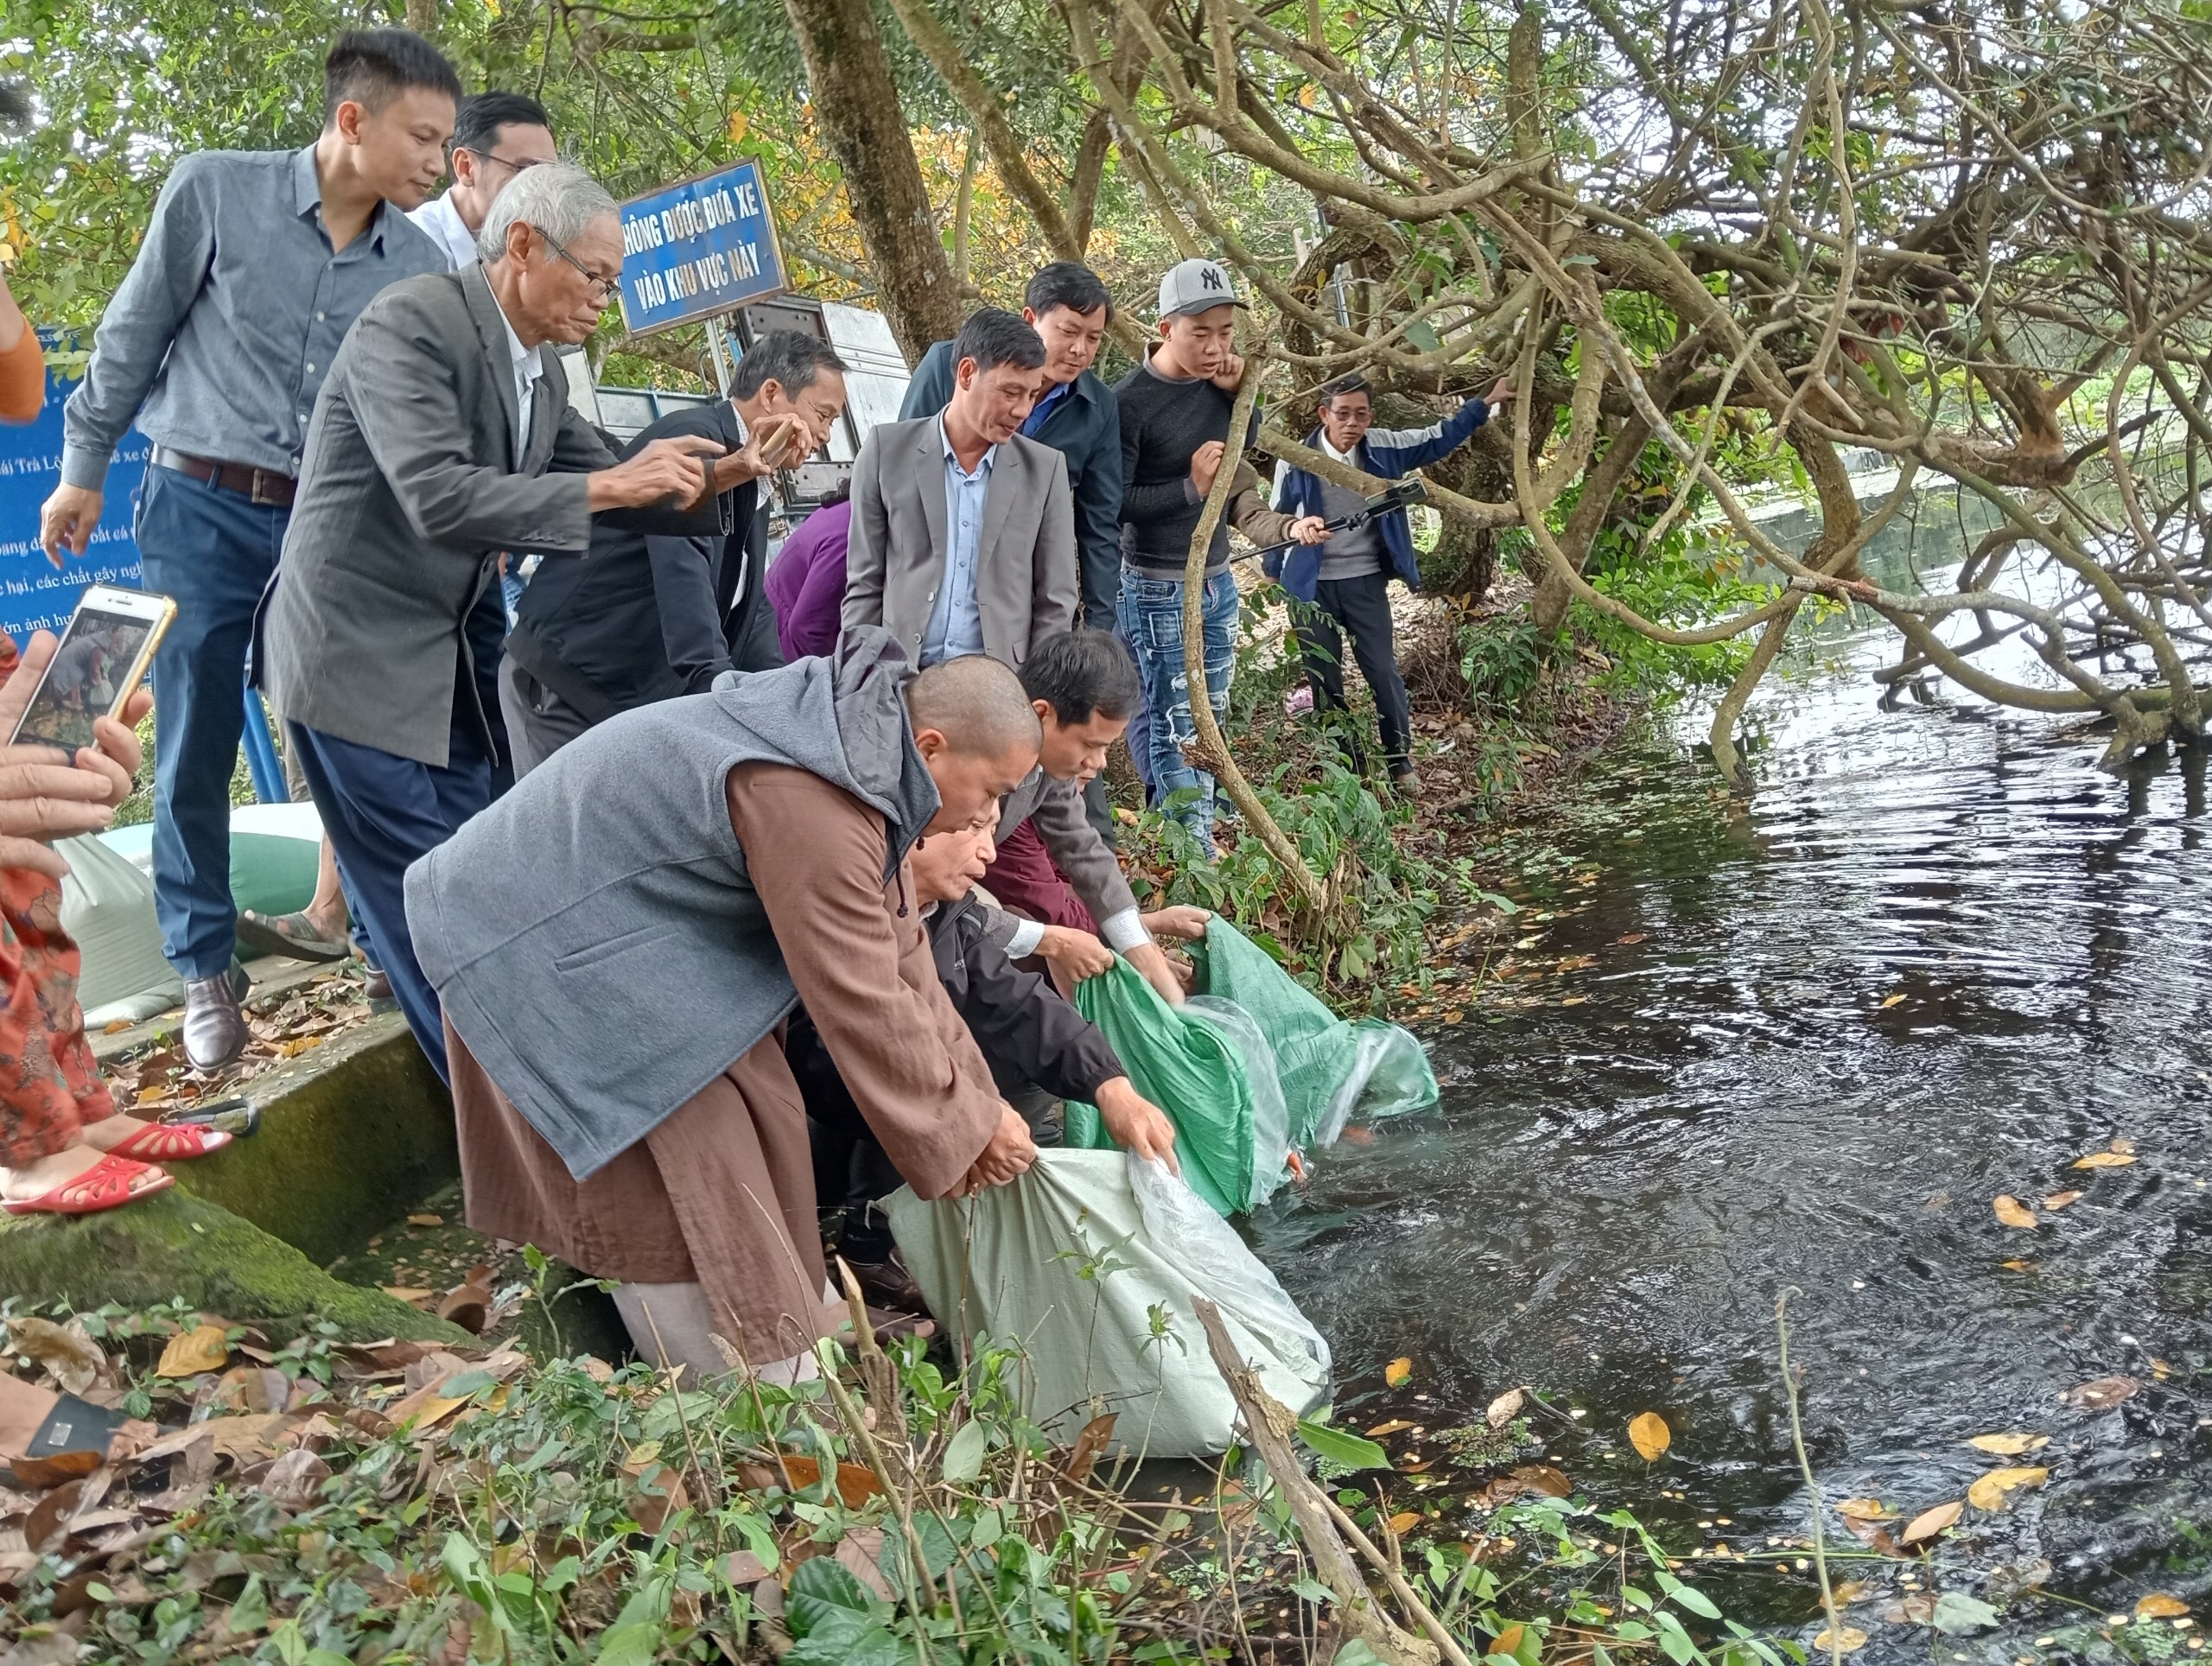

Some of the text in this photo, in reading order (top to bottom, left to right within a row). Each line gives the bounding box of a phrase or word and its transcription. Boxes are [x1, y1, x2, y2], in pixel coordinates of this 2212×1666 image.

[621, 182, 760, 258] HÔNG ĐƯỢC ĐƯA XE
[633, 239, 761, 311] VÀO KHU VỰC NÀY
[1201, 267, 1224, 290] NY
[43, 455, 63, 472] Lộ
[124, 449, 139, 463] xe
[0, 540, 29, 557] ang
[36, 574, 60, 589] các
[62, 565, 92, 585] chất
[94, 564, 118, 584] gây
[121, 561, 143, 580] ngh
[3, 621, 22, 634] ớn
[25, 614, 52, 632] ảnh
